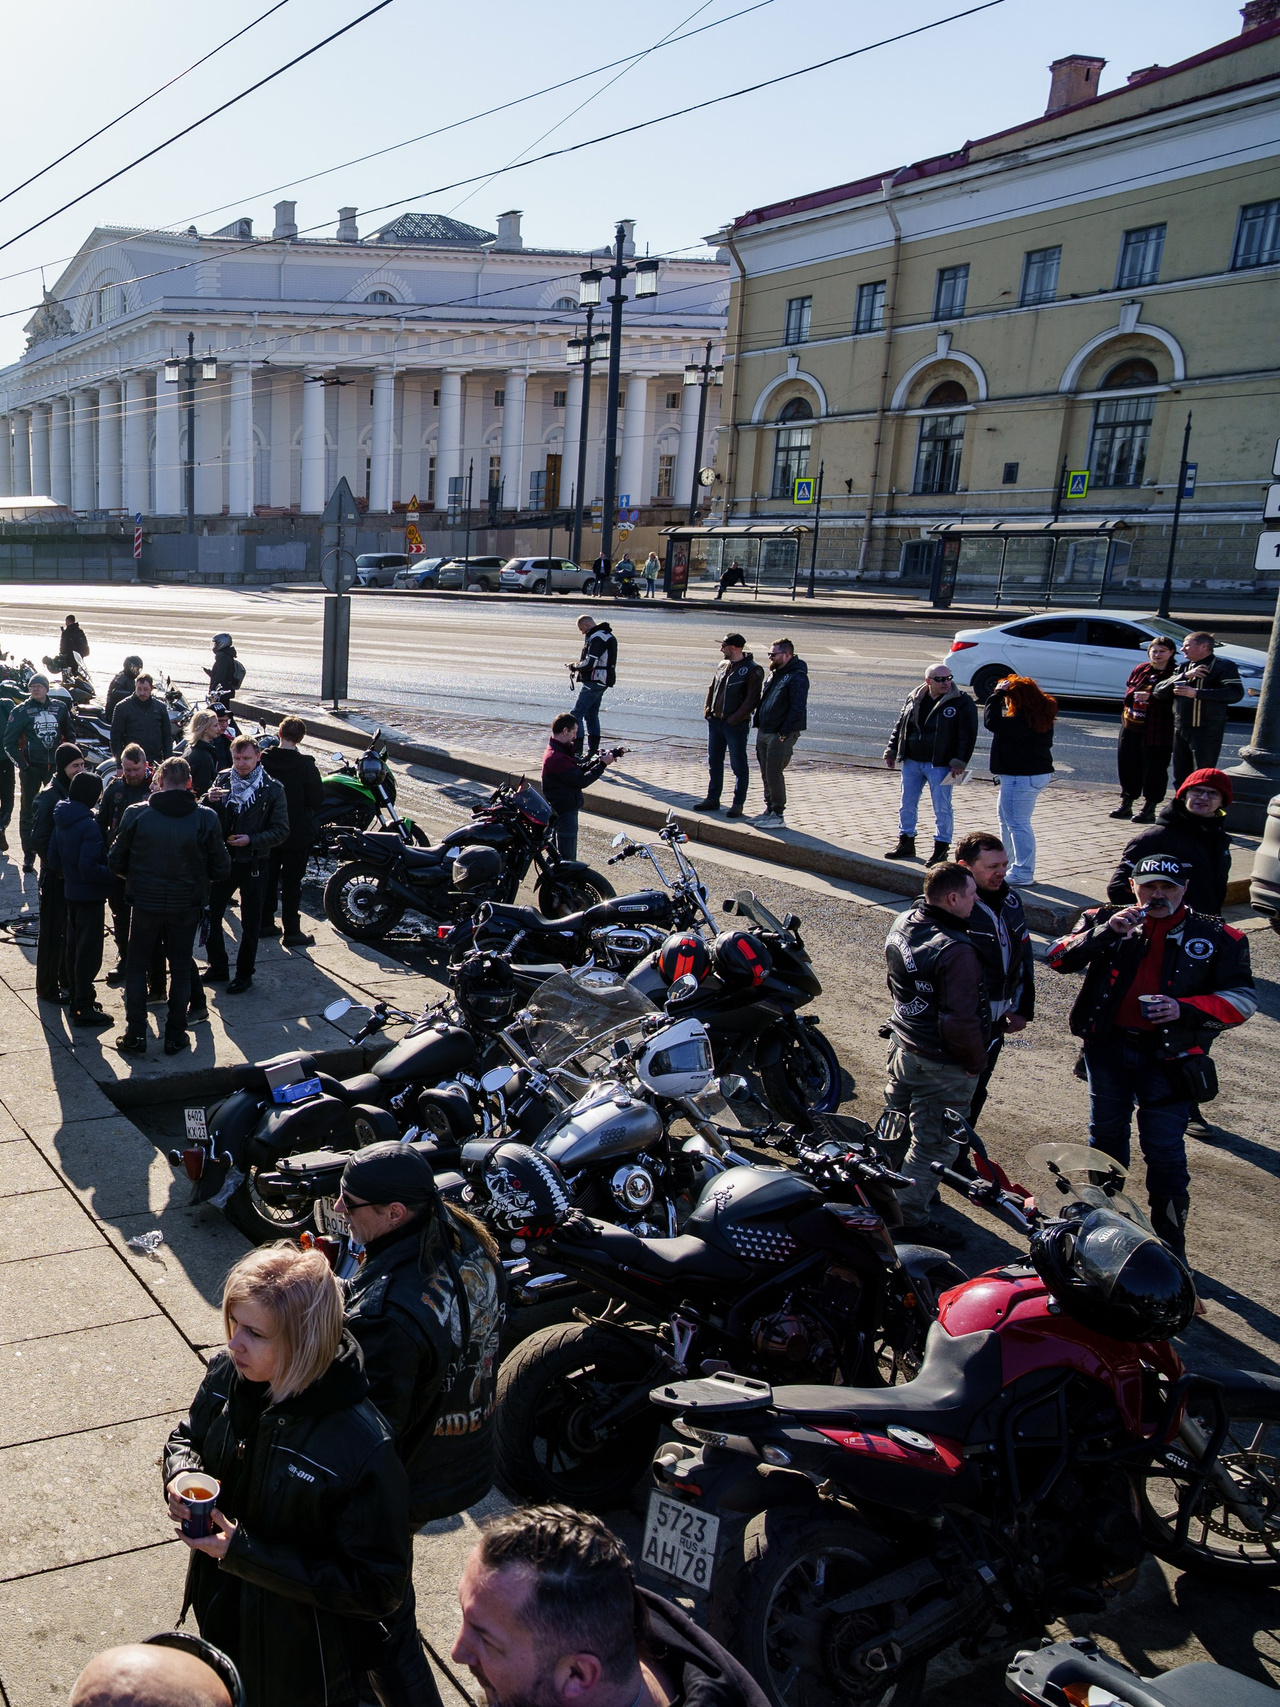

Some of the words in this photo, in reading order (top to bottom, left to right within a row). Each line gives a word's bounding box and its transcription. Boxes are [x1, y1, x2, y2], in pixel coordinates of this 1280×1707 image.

[187, 1110, 203, 1121] 6402
[187, 1126, 197, 1138] KX
[198, 1126, 206, 1138] 23
[338, 1219, 349, 1234] 78
[656, 1501, 706, 1543] 5723
[679, 1536, 699, 1552] RUS
[644, 1536, 676, 1570] AH
[681, 1549, 708, 1583] 78
